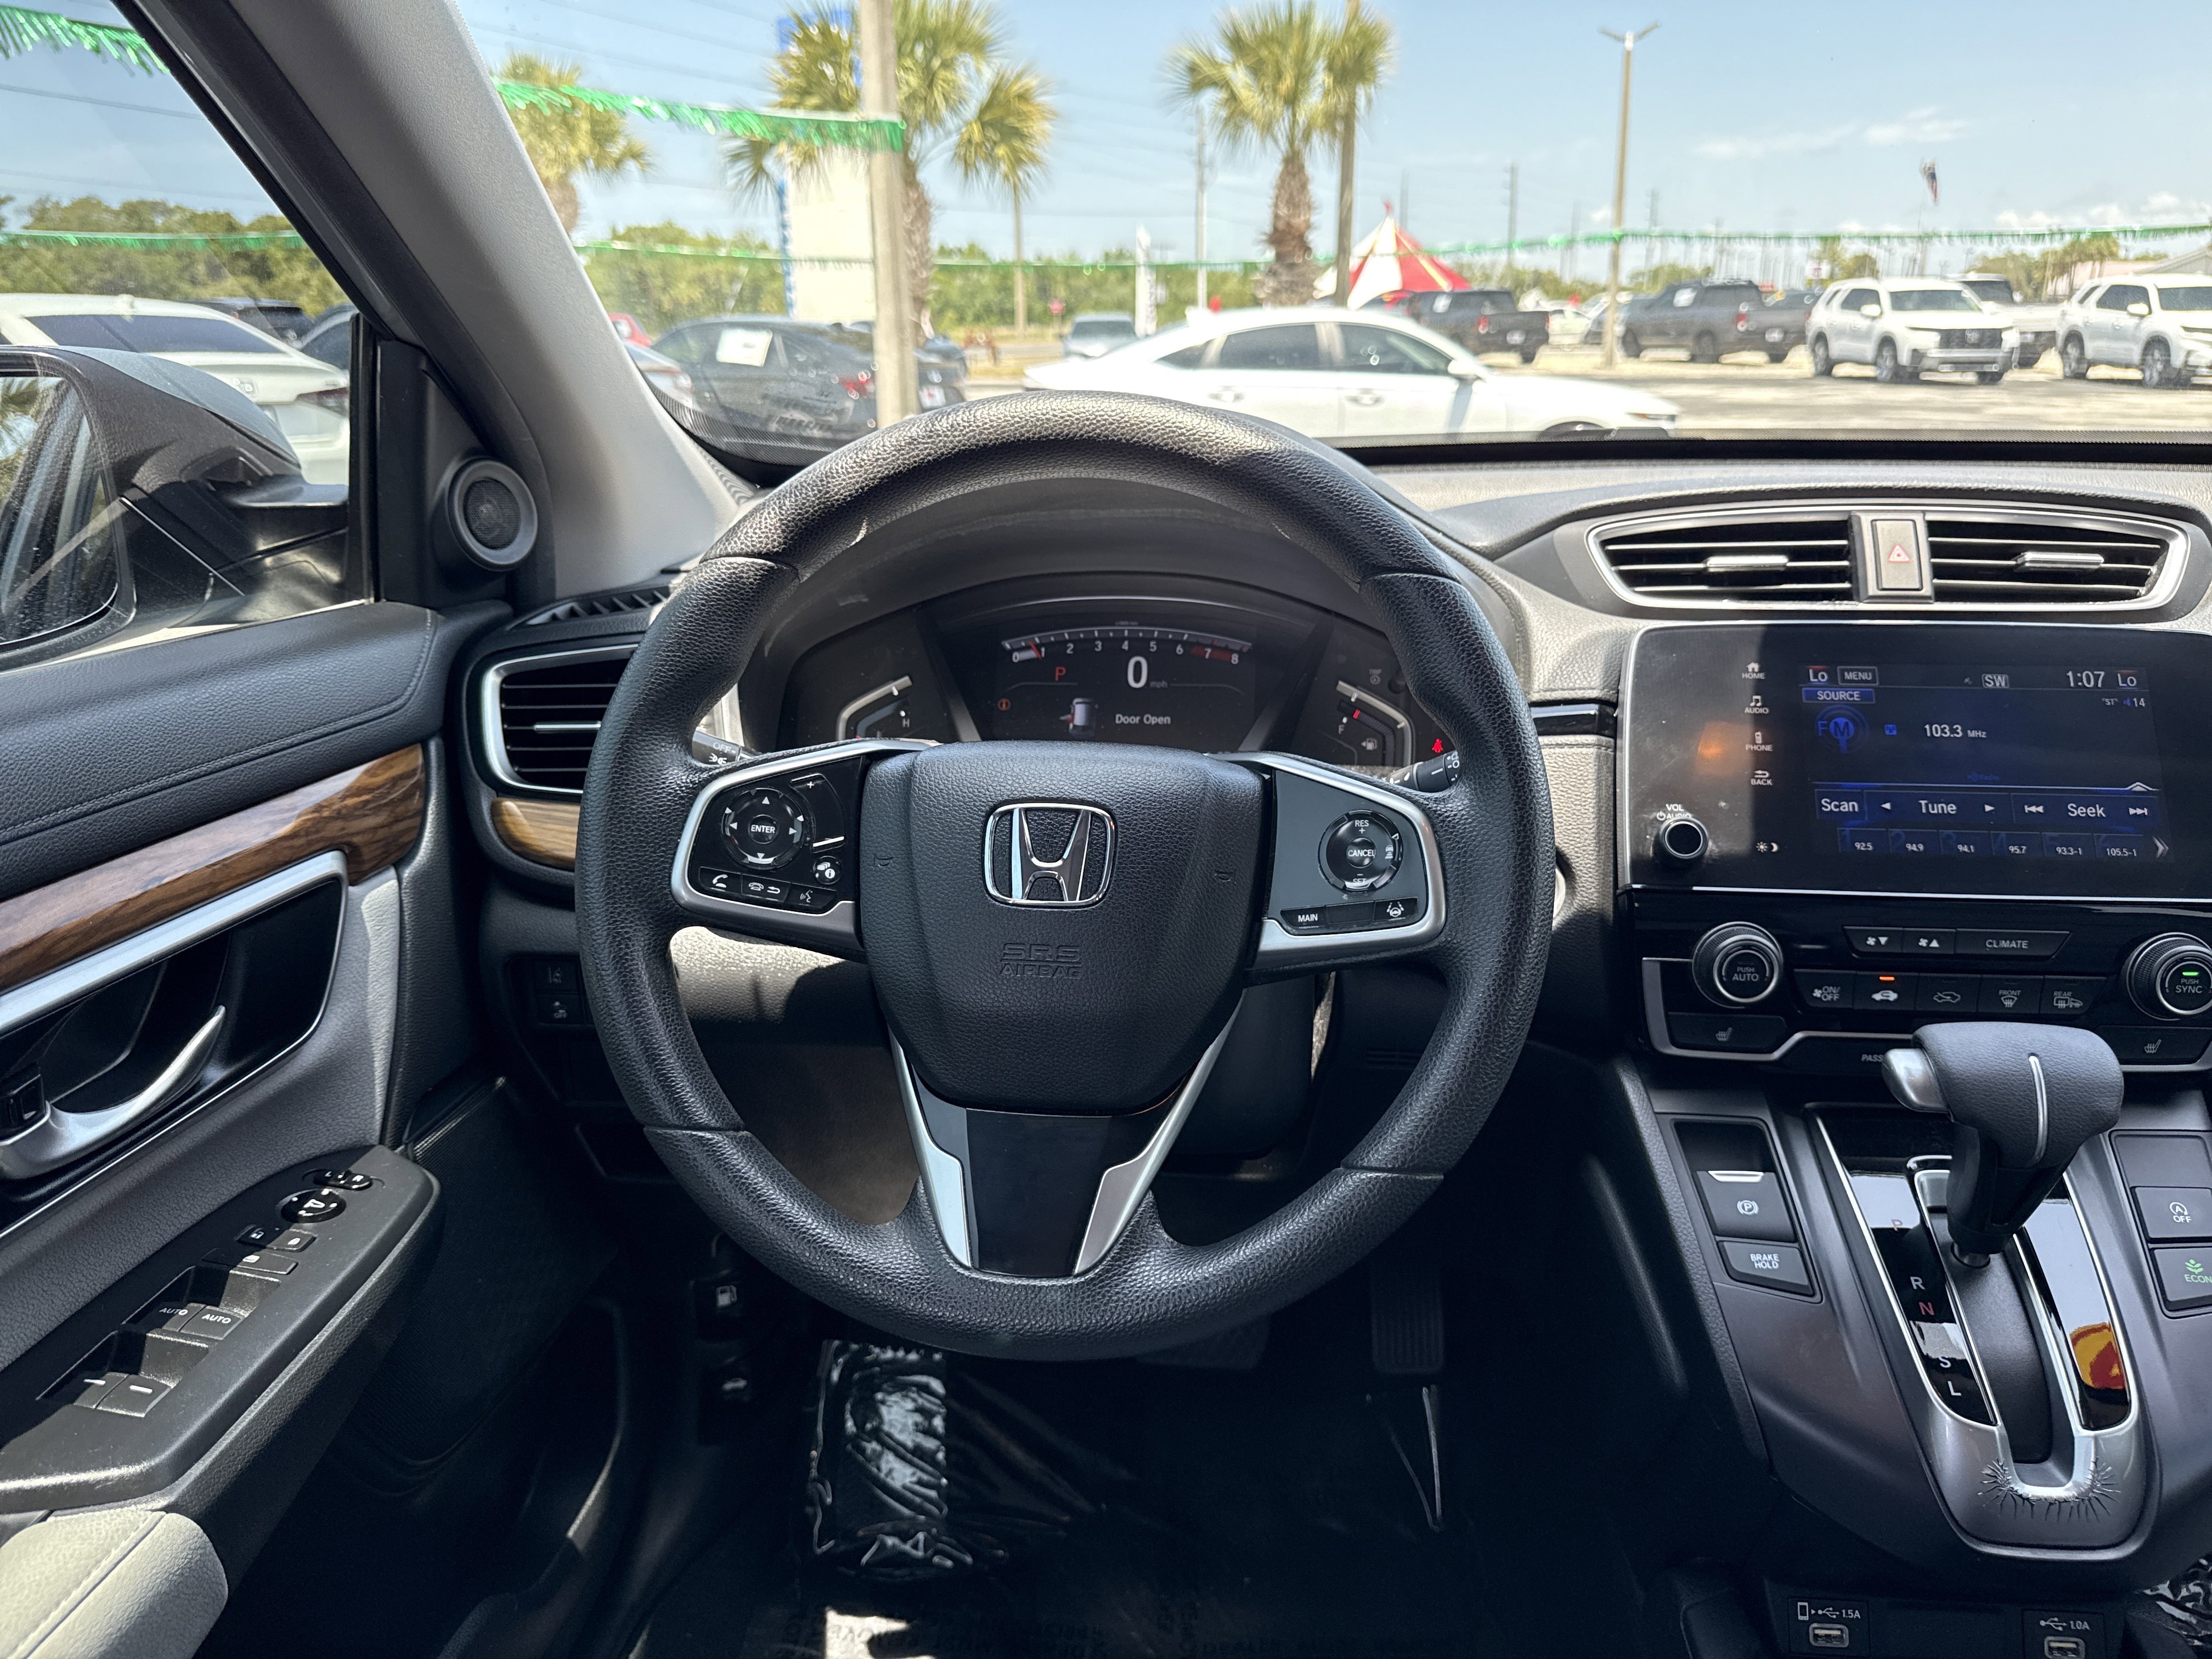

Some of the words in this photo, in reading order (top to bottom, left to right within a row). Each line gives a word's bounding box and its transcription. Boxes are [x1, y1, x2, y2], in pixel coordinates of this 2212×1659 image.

[1012, 653, 1019, 662] 0
[1041, 647, 1046, 657] 1
[1066, 644, 1074, 653] 2
[1094, 641, 1102, 651] 3
[1121, 640, 1128, 651] 4
[1149, 641, 1157, 652] 5
[1176, 645, 1183, 655] 6
[1205, 648, 1211, 658] 7
[1231, 654, 1239, 664] 8
[1055, 667, 1066, 681] P
[1127, 656, 1148, 688] 0
[1150, 680, 1167, 689] mph
[1809, 669, 1828, 682] Lo
[1844, 672, 1872, 680] MENU
[2066, 671, 2105, 687] 1:07
[2117, 673, 2137, 687] Lo
[1816, 691, 1860, 701] SOURCE
[2134, 698, 2145, 707] 14
[902, 718, 910, 727] H
[1115, 714, 1140, 724] Door
[1143, 715, 1171, 726] Open
[1339, 725, 1345, 734] F
[1818, 720, 1849, 737] FM
[1924, 724, 1962, 738] 103.3
[1967, 730, 1987, 738] MHz
[713, 742, 731, 753] OFF
[1821, 798, 1859, 812] Scan
[1919, 800, 1957, 814] Tune
[2068, 804, 2106, 818] Seek
[751, 825, 775, 834] ENTER
[1854, 842, 1873, 850] 92.5
[2008, 845, 2027, 854] 95.7
[2056, 847, 2083, 855] 93.3-1
[2107, 848, 2137, 856] 105.5-1
[1298, 913, 1318, 922] MAIN
[1985, 940, 2028, 949] CLIMATE
[1003, 943, 1080, 961] SRS
[1000, 964, 1082, 979] AIRBAG
[1733, 973, 1759, 981] AUTO
[2175, 985, 2202, 994] SYNC
[1910, 1277, 1925, 1290] R
[2184, 1274, 2212, 1283] ECON
[1918, 1302, 1935, 1315] N
[202, 1314, 231, 1323] AUTO
[1938, 1357, 1951, 1368] S
[1948, 1381, 1961, 1396] L
[1842, 1609, 1861, 1619] 1.5A
[2069, 1620, 2090, 1630] 1.0A
